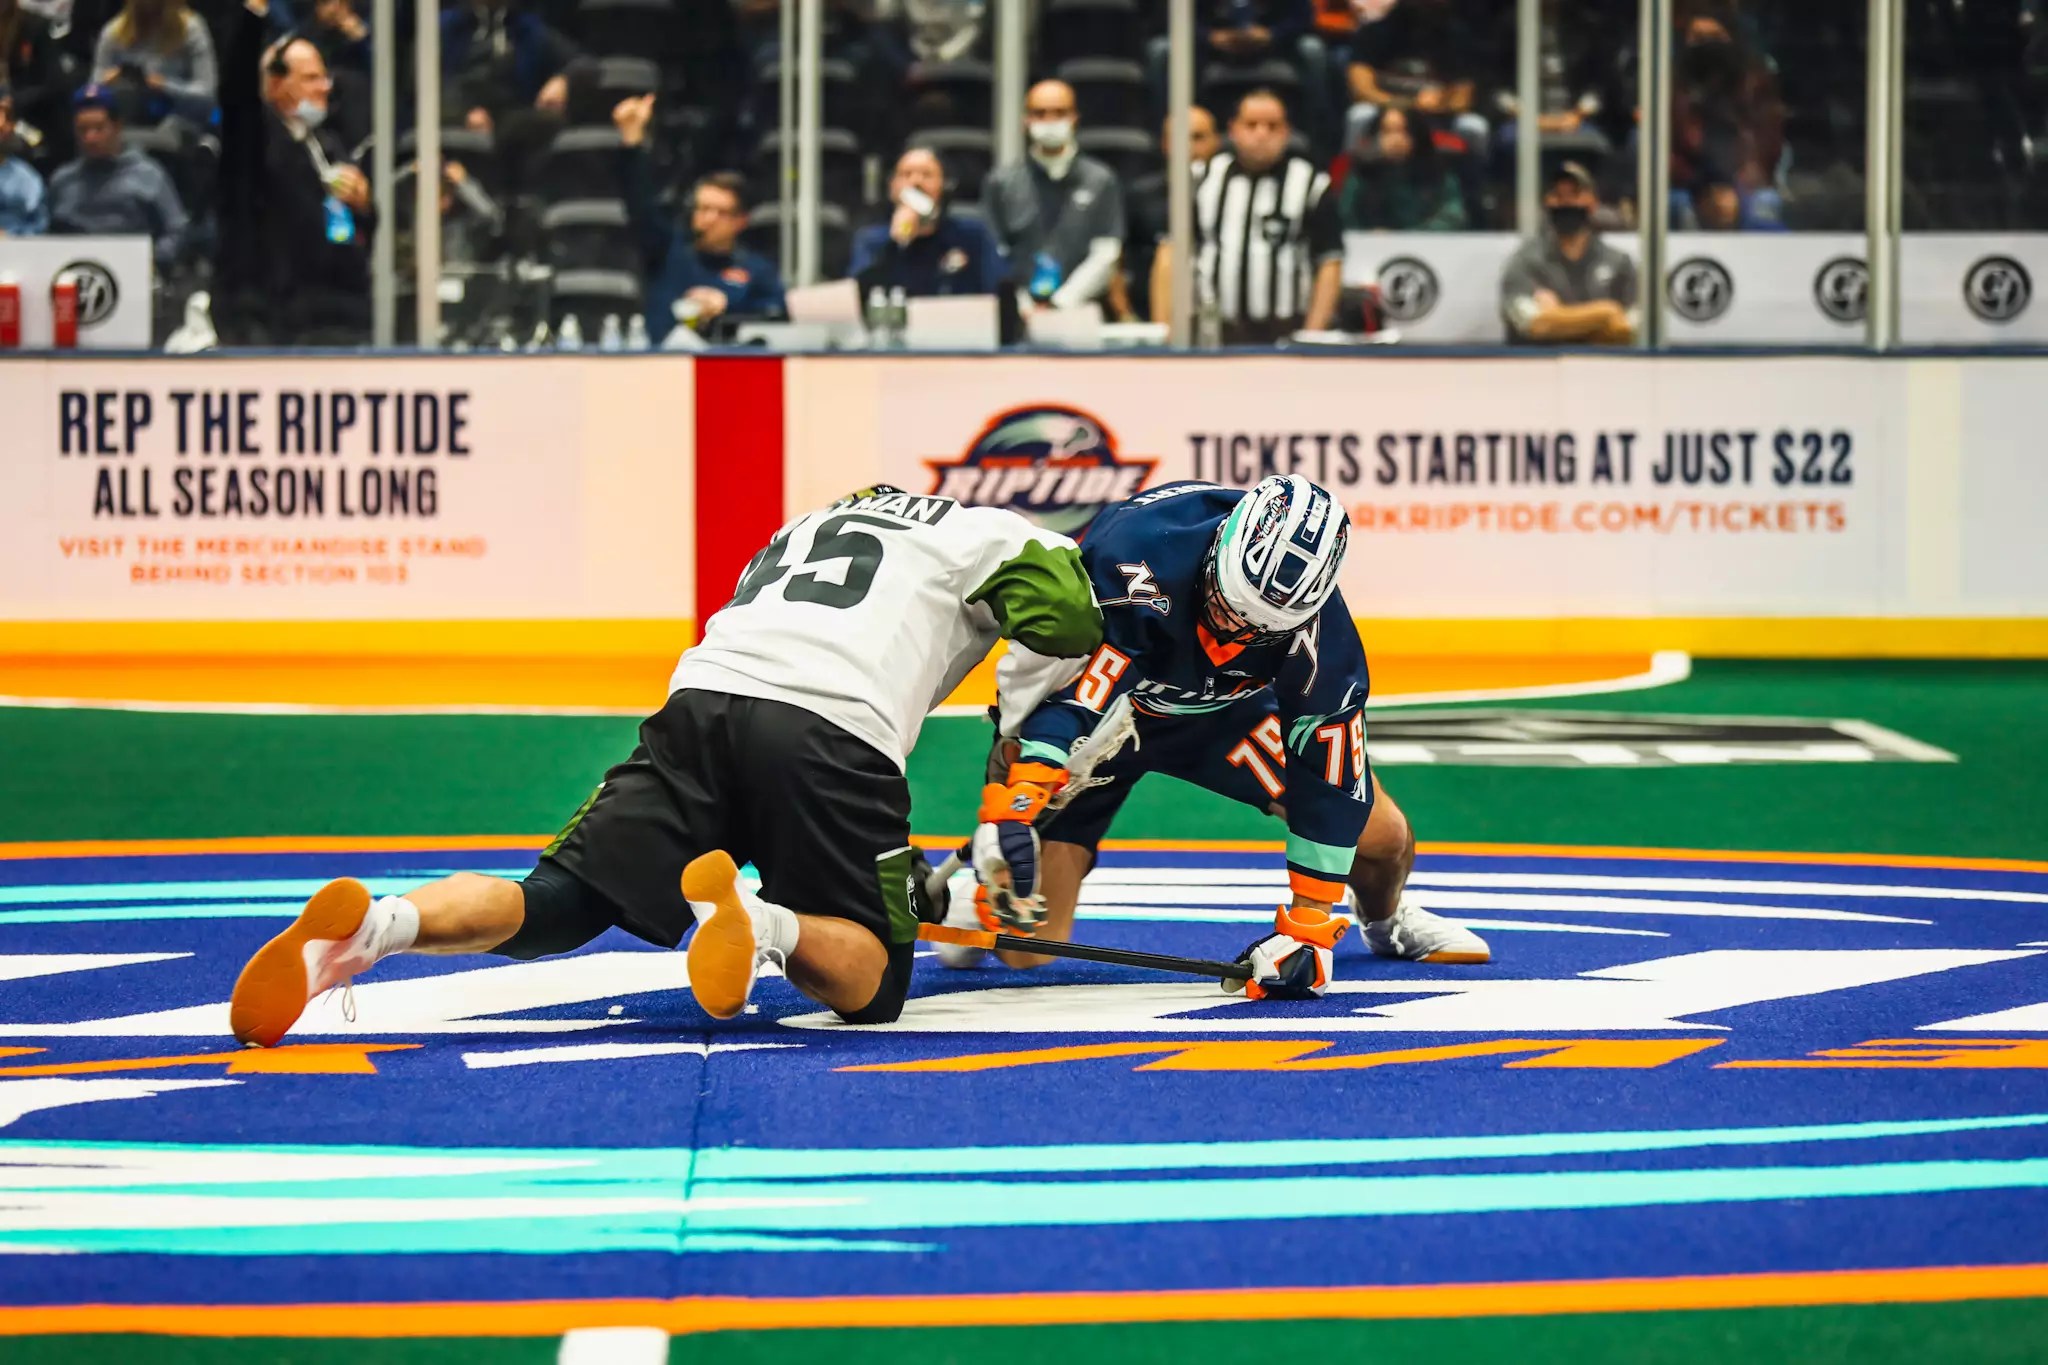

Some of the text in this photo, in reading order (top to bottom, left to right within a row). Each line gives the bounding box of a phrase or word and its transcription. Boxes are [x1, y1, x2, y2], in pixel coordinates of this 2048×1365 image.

[58, 391, 469, 456] REP THE RIPTIDE
[934, 463, 1146, 505] RIPTIDE
[1188, 429, 1853, 487] TICKETS STARTING AT JUST $22
[93, 466, 437, 517] ALL SEASON LONG
[59, 536, 487, 558] VISIT THE MERCHANDISE STAND
[129, 563, 231, 583] BEHIND
[241, 563, 358, 583] SECTION
[720, 512, 912, 610] 45
[1315, 709, 1364, 788] 75
